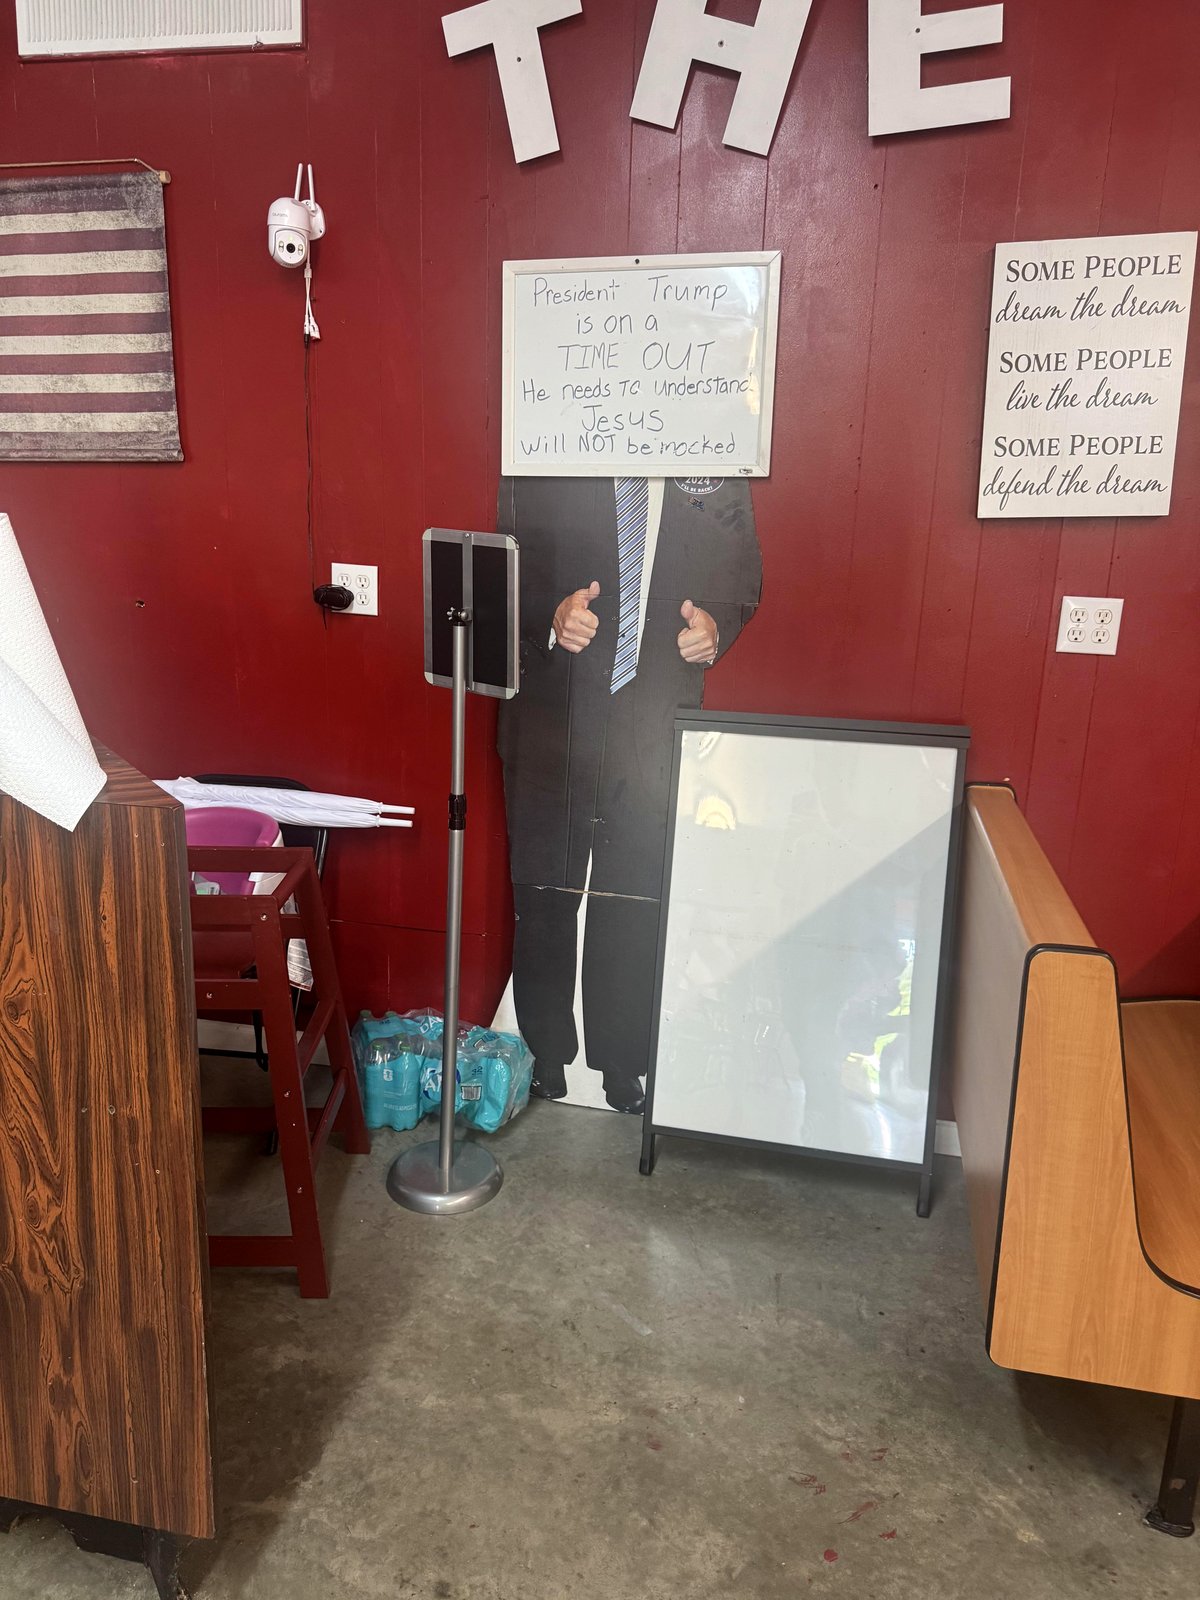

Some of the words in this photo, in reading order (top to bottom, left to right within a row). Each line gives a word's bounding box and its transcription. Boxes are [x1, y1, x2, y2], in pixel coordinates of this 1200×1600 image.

[441, 0, 1011, 164] THE
[534, 277, 620, 307] President
[648, 275, 728, 310] Trump
[995, 290, 1067, 322] dream
[1070, 285, 1107, 321] the
[1111, 284, 1186, 320] dream
[576, 314, 594, 334] is
[604, 314, 632, 334] on
[644, 314, 658, 331] a
[558, 342, 619, 372] TIME
[642, 340, 716, 374] OUT
[522, 379, 550, 403] He
[562, 378, 611, 400] needs
[1006, 379, 1042, 411] live
[1046, 377, 1081, 411] the
[1085, 376, 1159, 409] dream
[581, 404, 664, 432] Jesus
[578, 433, 616, 454] NOT
[627, 437, 654, 455] be
[660, 432, 736, 456] mocked
[983, 465, 1057, 511] defend
[1057, 464, 1092, 497] the
[1096, 464, 1168, 496] dream
